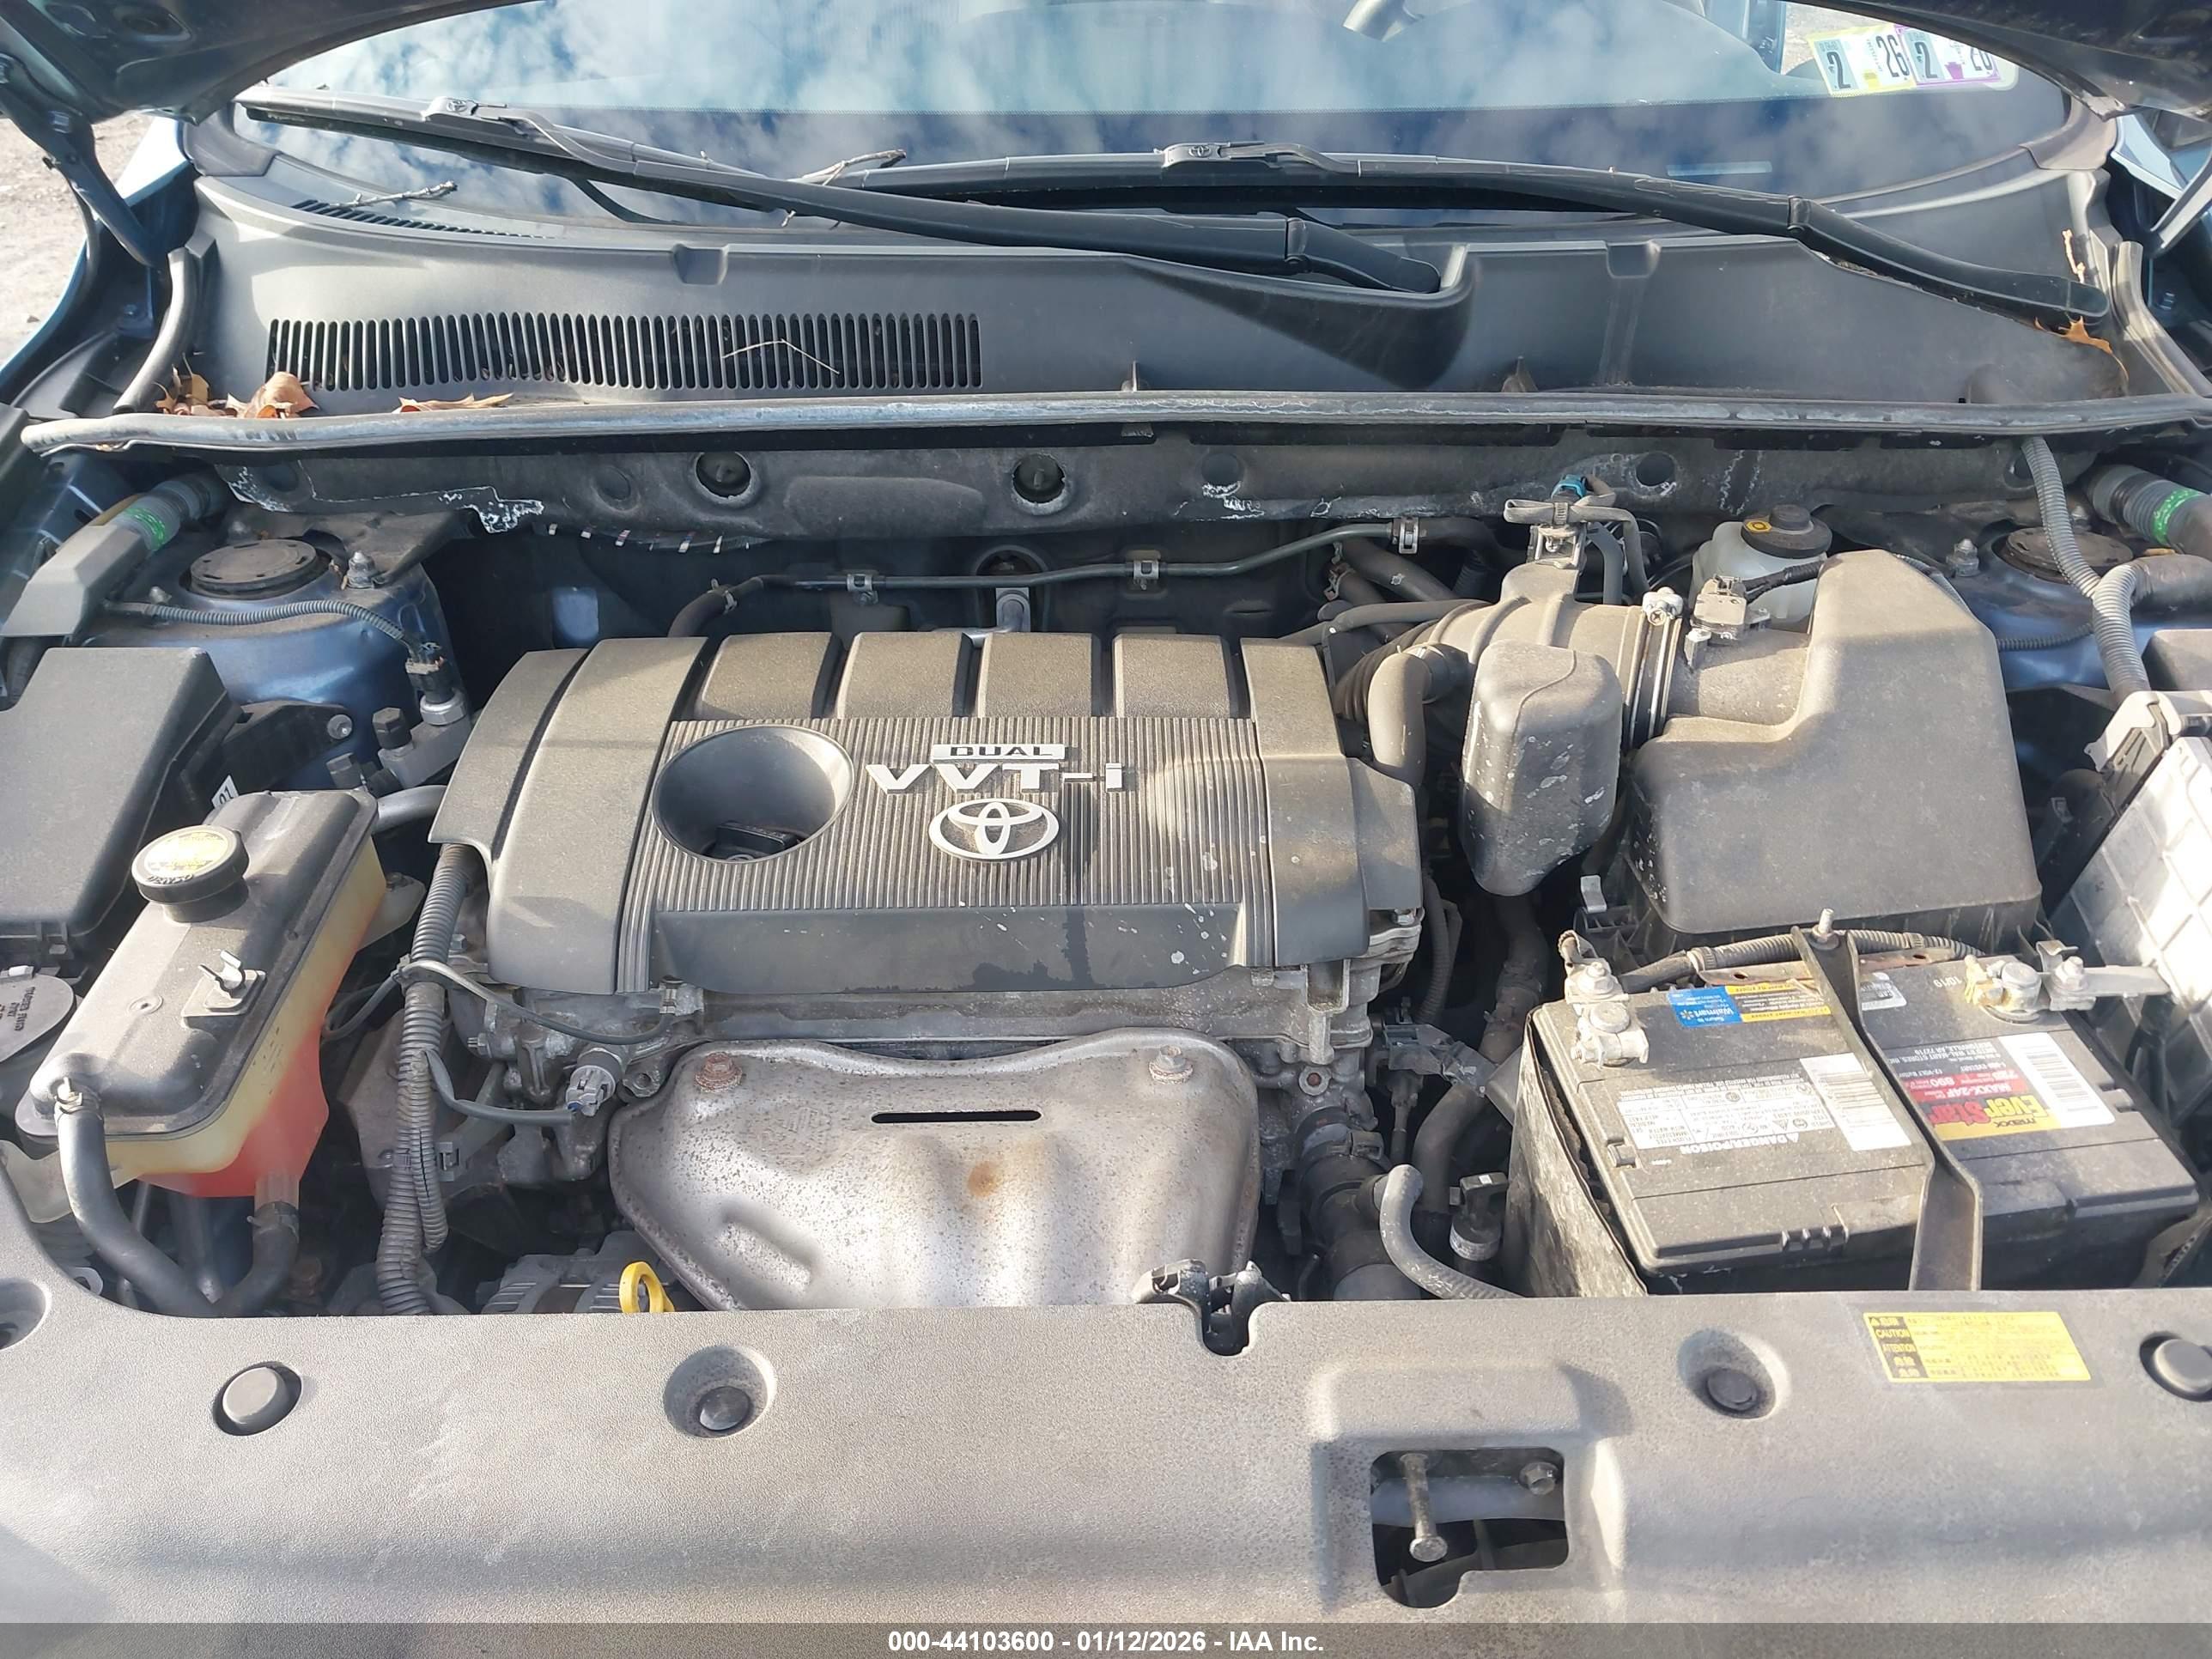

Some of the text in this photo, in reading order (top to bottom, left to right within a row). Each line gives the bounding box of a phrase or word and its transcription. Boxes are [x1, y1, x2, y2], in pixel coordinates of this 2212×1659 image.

[1875, 34, 1910, 78] 26
[950, 746, 1054, 757] DUAL
[866, 763, 1123, 793] VVT-i
[1932, 976, 1963, 988] 10/19
[1692, 1007, 1735, 1018] Walmart
[1929, 1077, 1955, 1086] 890
[1945, 1084, 2012, 1097] MAXX-24F
[1929, 1095, 2049, 1128] EverStar
[1993, 1117, 2036, 1128] maxx
[1680, 1135, 1788, 1154] DANGER/POISON
[1875, 1328, 1911, 1339] CAUTION
